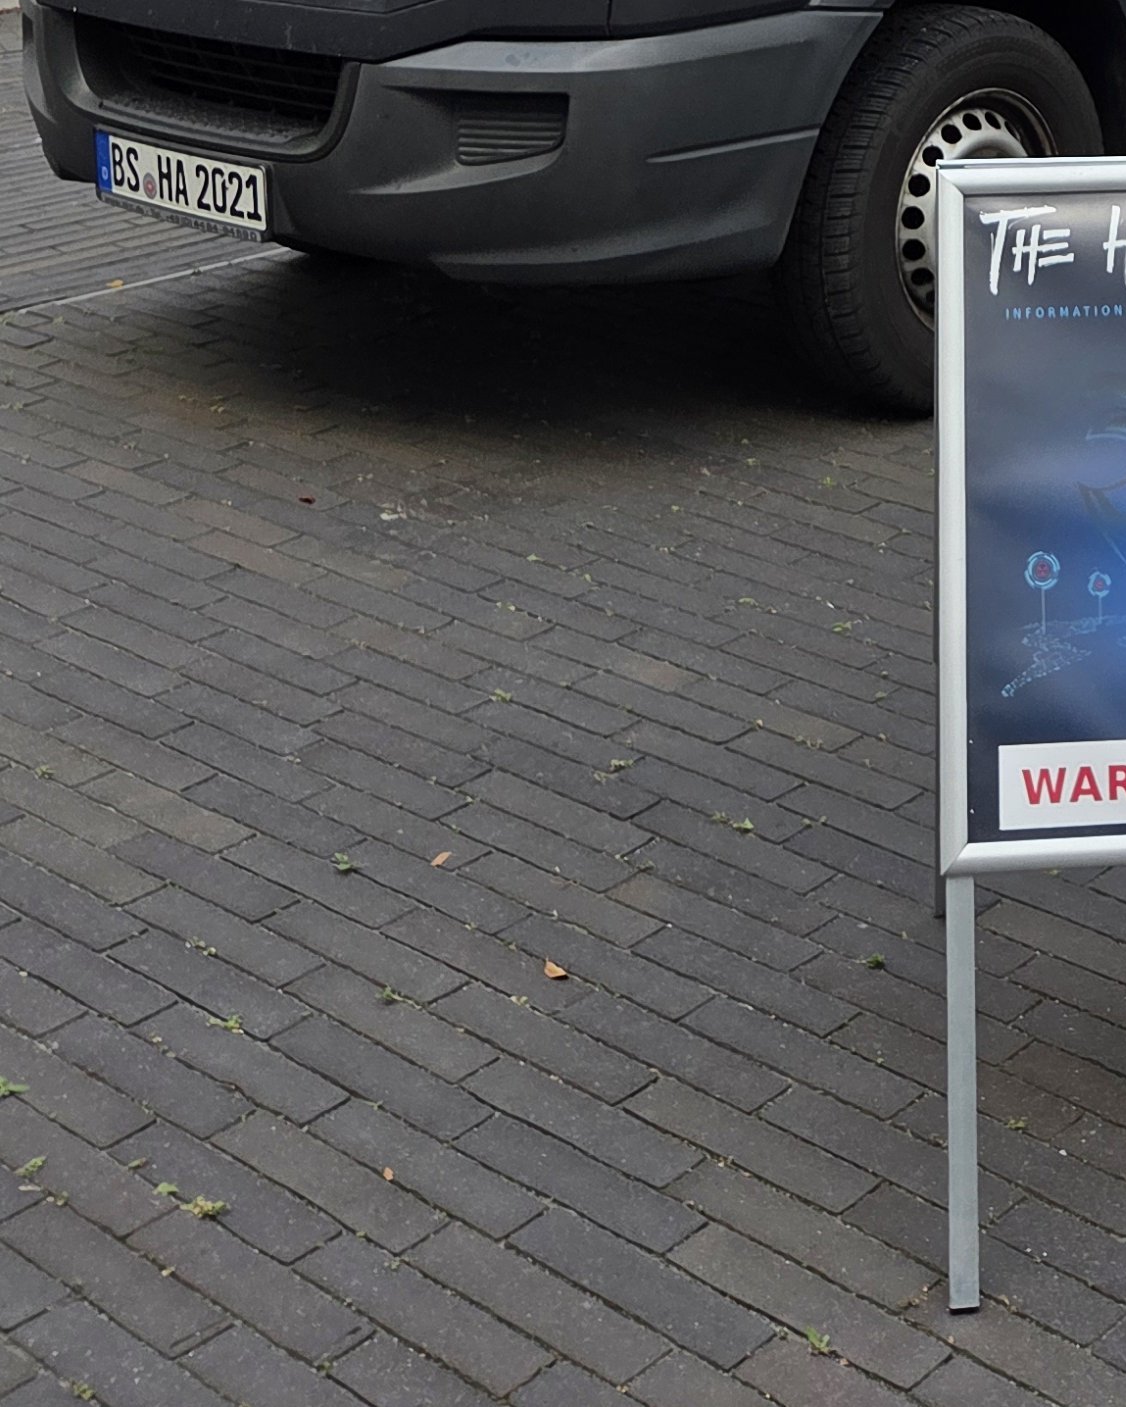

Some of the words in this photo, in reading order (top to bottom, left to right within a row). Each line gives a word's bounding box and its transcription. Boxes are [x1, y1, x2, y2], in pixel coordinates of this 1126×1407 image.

[111, 142, 140, 192] BS
[157, 154, 189, 207] HA
[195, 163, 263, 222] 2021
[979, 206, 1075, 295] THE
[1005, 303, 1123, 320] INFORMATION
